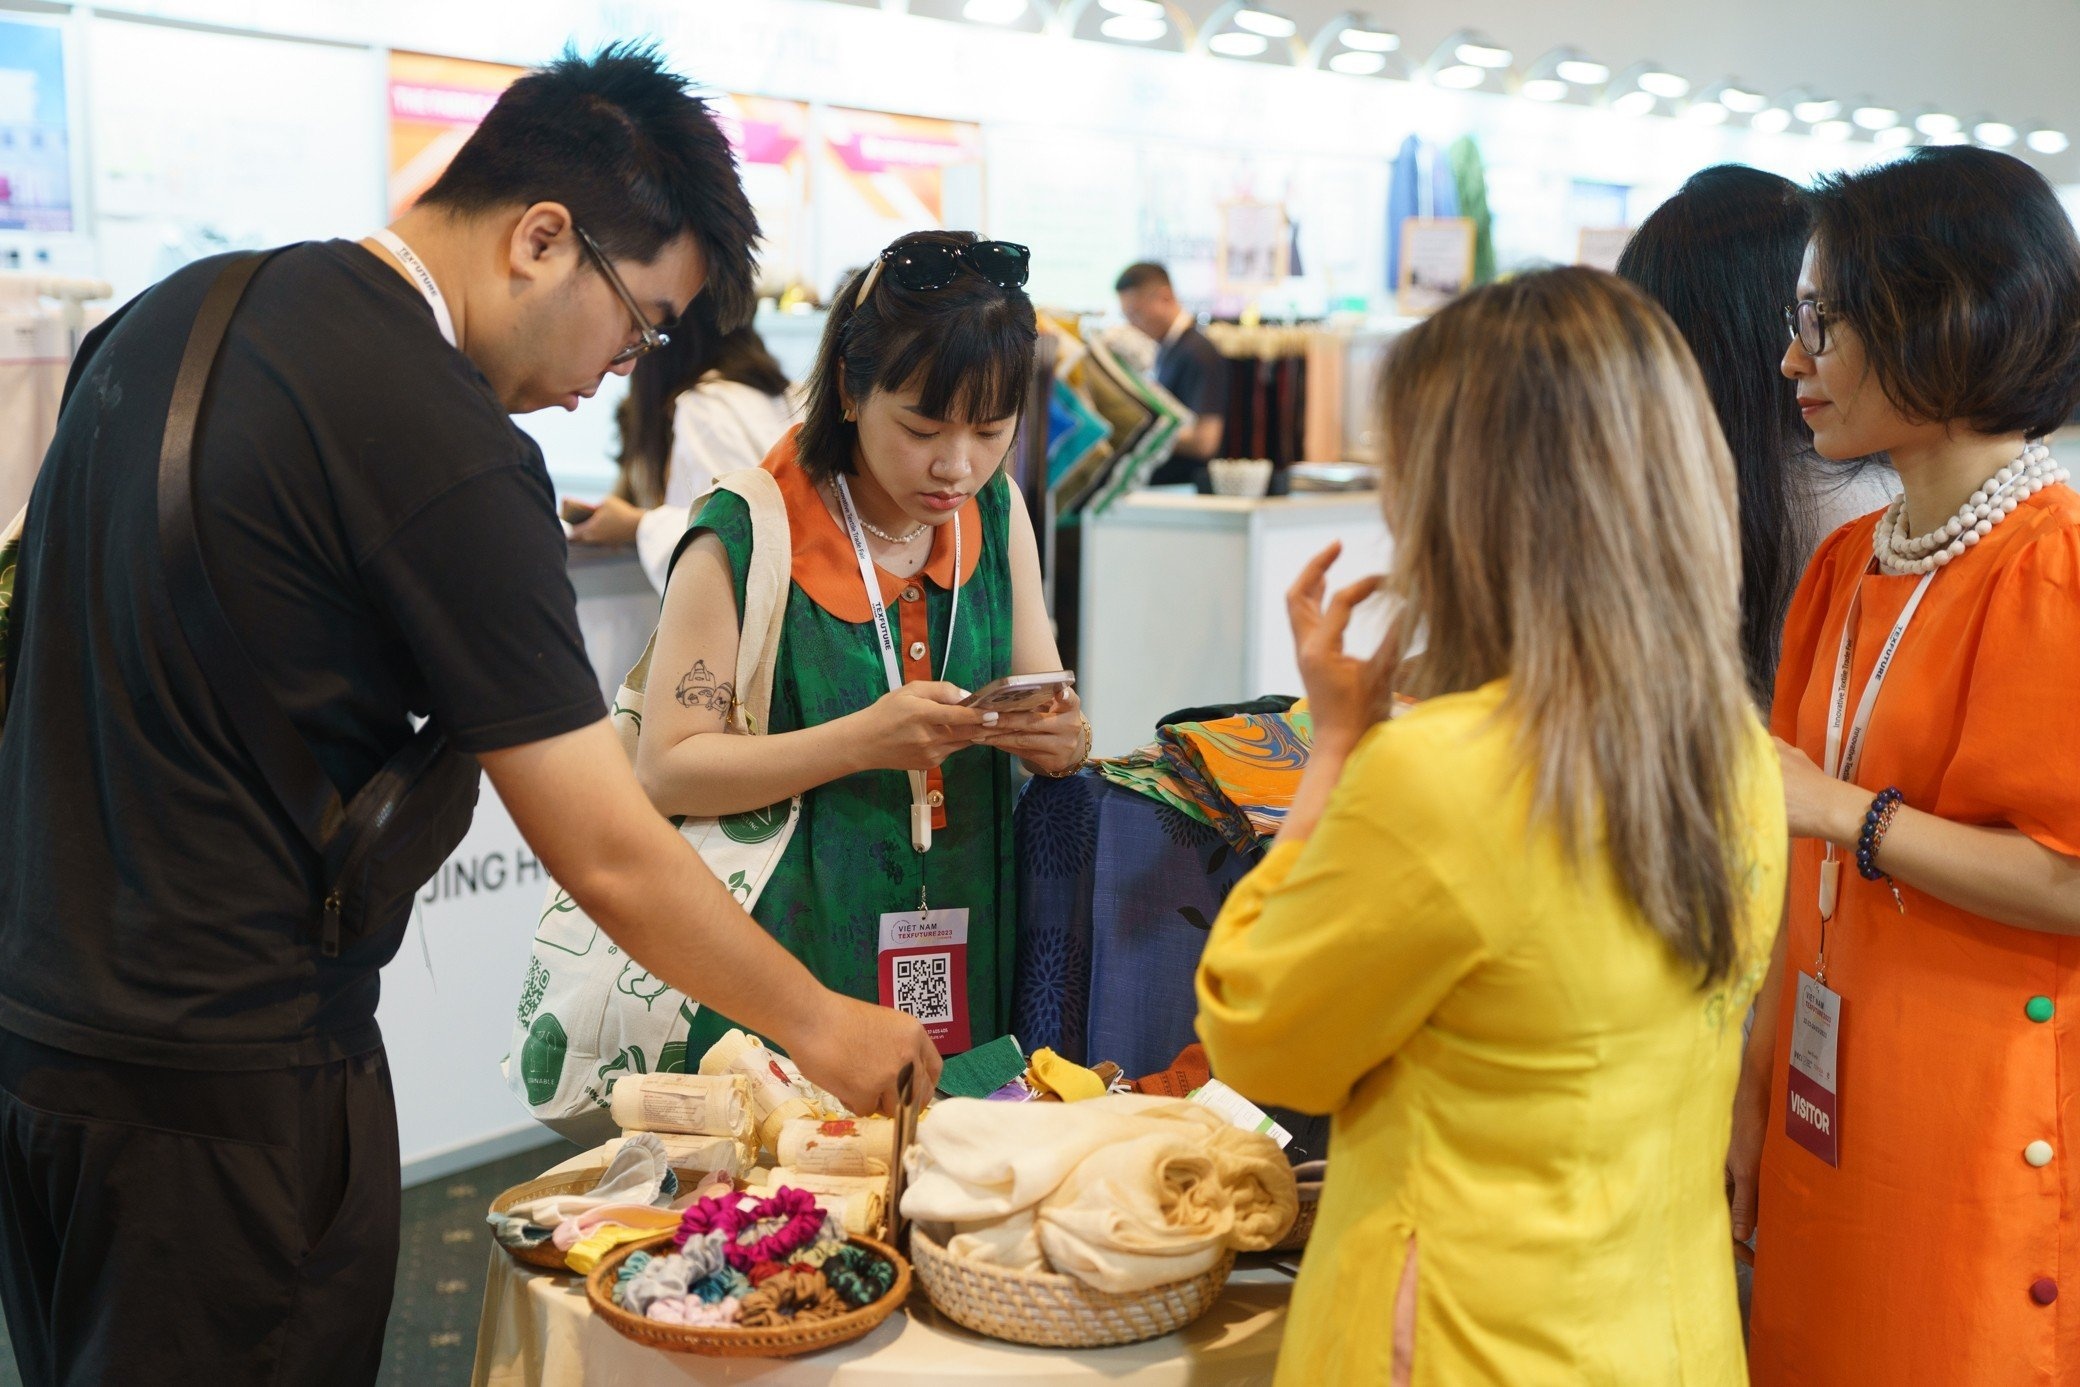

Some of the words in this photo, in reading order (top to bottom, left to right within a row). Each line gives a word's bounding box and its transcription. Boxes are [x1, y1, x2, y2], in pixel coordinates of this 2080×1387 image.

[400, 247, 437, 297] TEXFUTURE
[838, 483, 850, 513] Innovative
[847, 513, 857, 532] Textile
[853, 531, 862, 548] Trade
[858, 548, 866, 560] Fair
[875, 601, 892, 650] TEXFUTURE
[1842, 651, 1851, 669] Trade
[1875, 625, 1904, 681] TEXFUTURE
[1838, 670, 1848, 692] Textile
[1833, 692, 1845, 728] Innovative
[1847, 726, 1862, 761] Innovative
[1791, 1090, 1830, 1135] VISITOR
